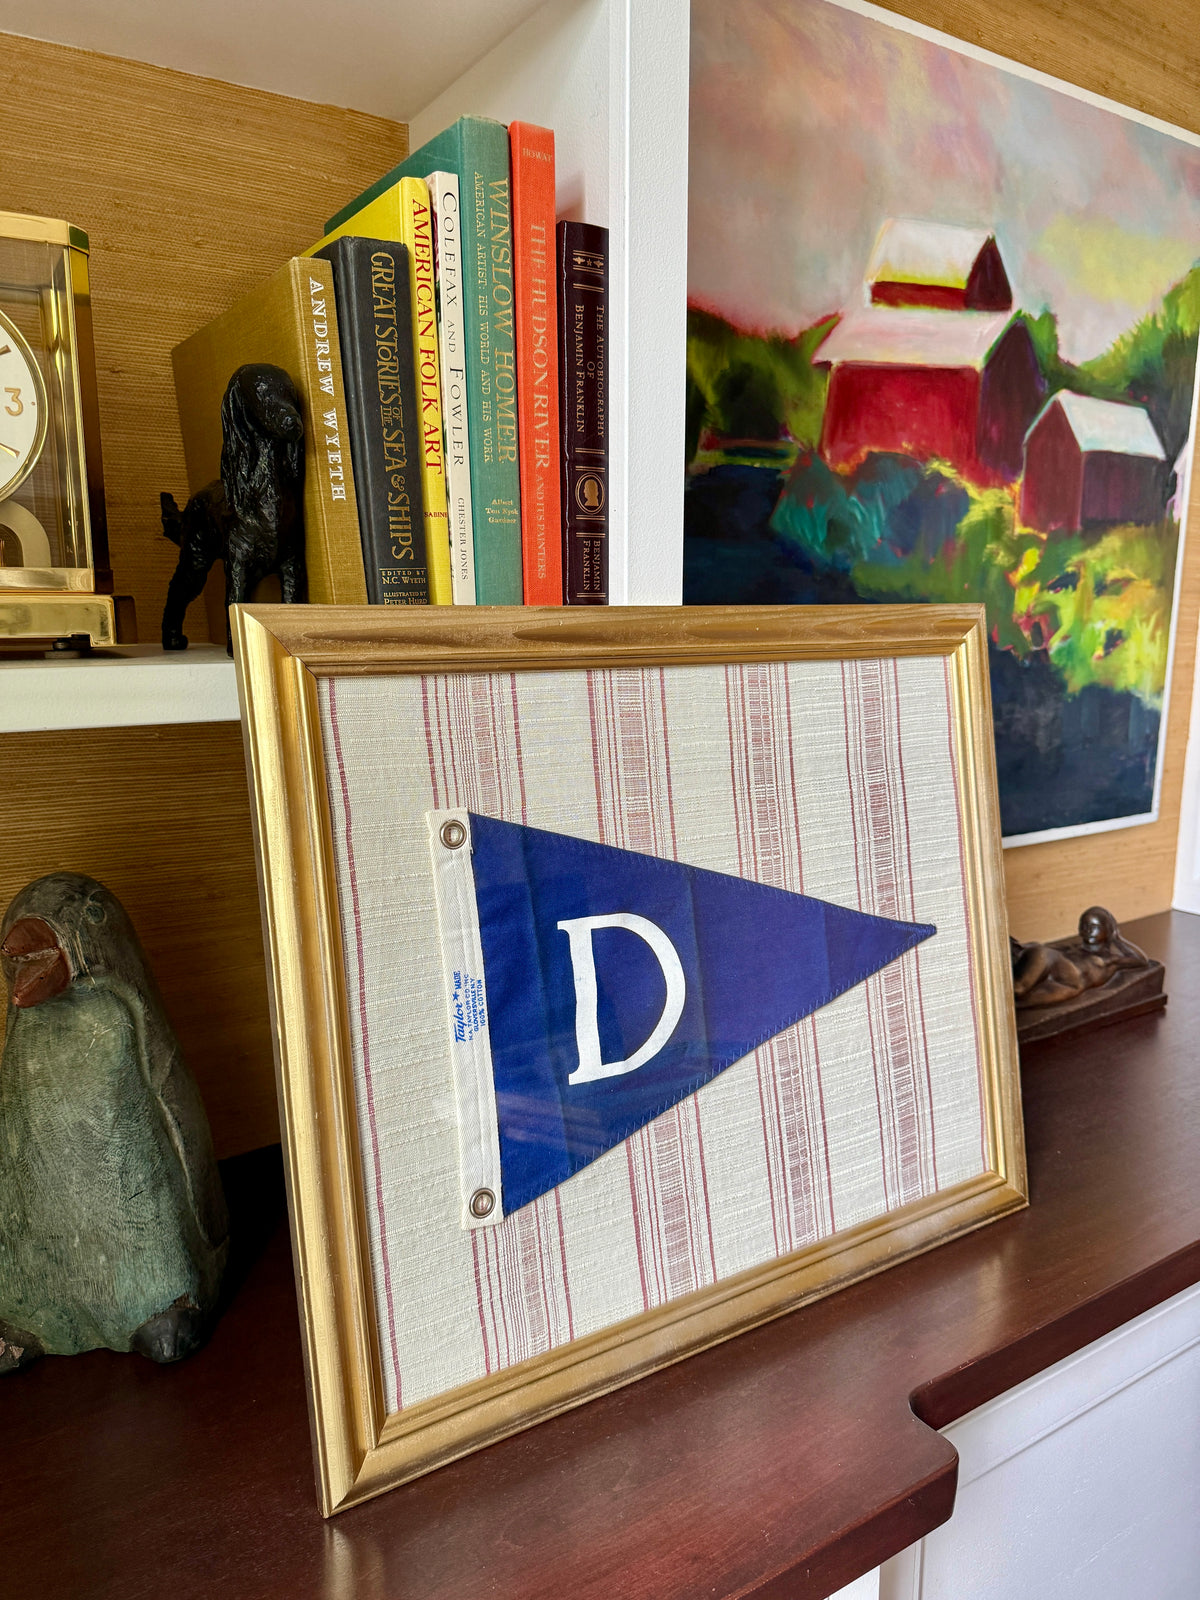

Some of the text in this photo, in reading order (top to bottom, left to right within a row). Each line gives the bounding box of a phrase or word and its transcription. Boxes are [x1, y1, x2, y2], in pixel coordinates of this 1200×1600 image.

[371, 252, 397, 326] GREAT
[474, 171, 493, 463] AMERICAN ARTIST: HIS WORLD AND HIS WORK
[489, 177, 517, 464] WINSLOW HOMER
[412, 198, 442, 475] AMERICAN FOLK ART
[443, 192, 464, 466] COLEFAX AND FOWLER
[309, 276, 346, 501] ANDREW WYETH
[375, 324, 402, 405] STORIES
[573, 304, 585, 433] BENJAMIN FRANKLIN
[586, 361, 595, 379] OF
[596, 304, 605, 438] THE AUTOBIOGRAPHY
[4, 387, 24, 416] 3
[382, 406, 393, 426] THE
[530, 220, 550, 579] THE HUDSON RIVER AND ITS PAINTERS
[383, 427, 407, 472] SEA
[391, 474, 405, 492] &
[388, 492, 414, 560] SHIPS
[457, 497, 469, 580] CHESTER JONES
[381, 576, 400, 585] N.C.
[583, 540, 591, 591] FRANKLIN
[593, 540, 601, 591] BENJAMIN
[453, 1002, 467, 1043] Taylor
[465, 1000, 473, 1027] TAYLOR
[470, 990, 479, 1032] GLOVERSVILLE
[476, 979, 486, 1027] 100% COTTON
[557, 912, 686, 1085] D
